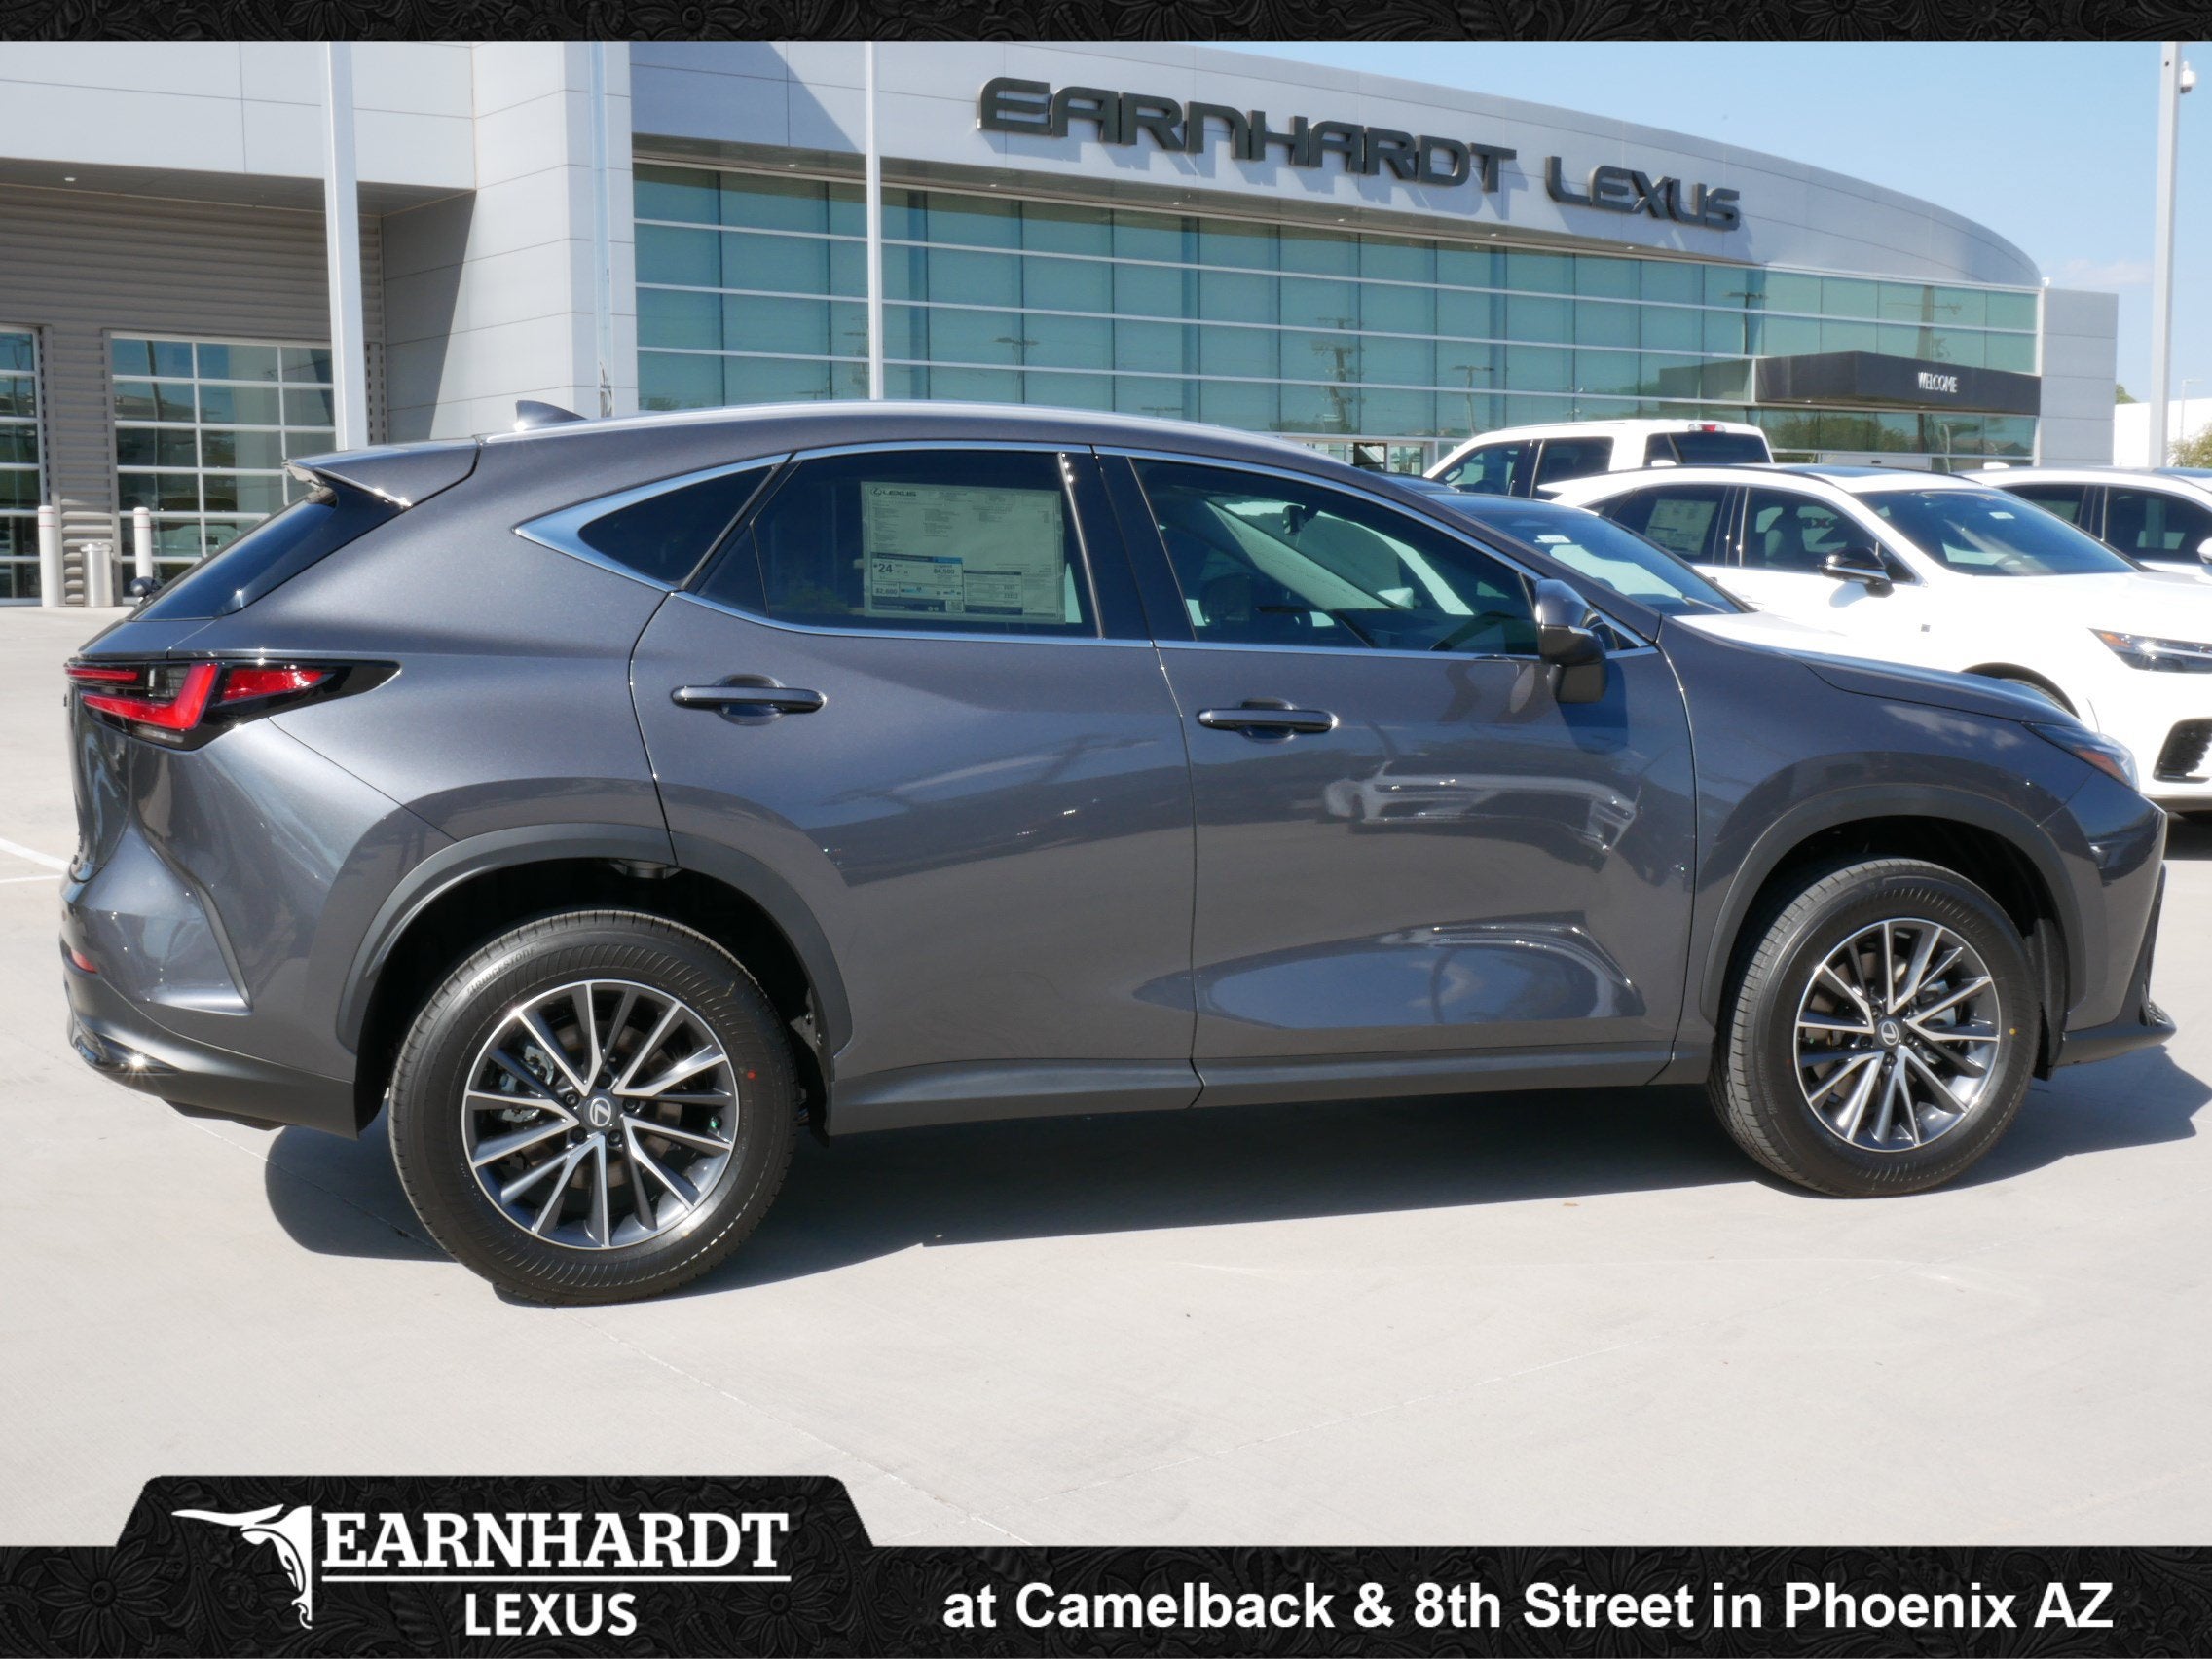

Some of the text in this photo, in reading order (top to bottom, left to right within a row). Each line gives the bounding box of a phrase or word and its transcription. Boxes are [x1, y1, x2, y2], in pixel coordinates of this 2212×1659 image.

[977, 77, 1741, 232] EARNHARDT LEXUS
[1917, 372, 1958, 393] WELCOME
[878, 563, 893, 573] 24
